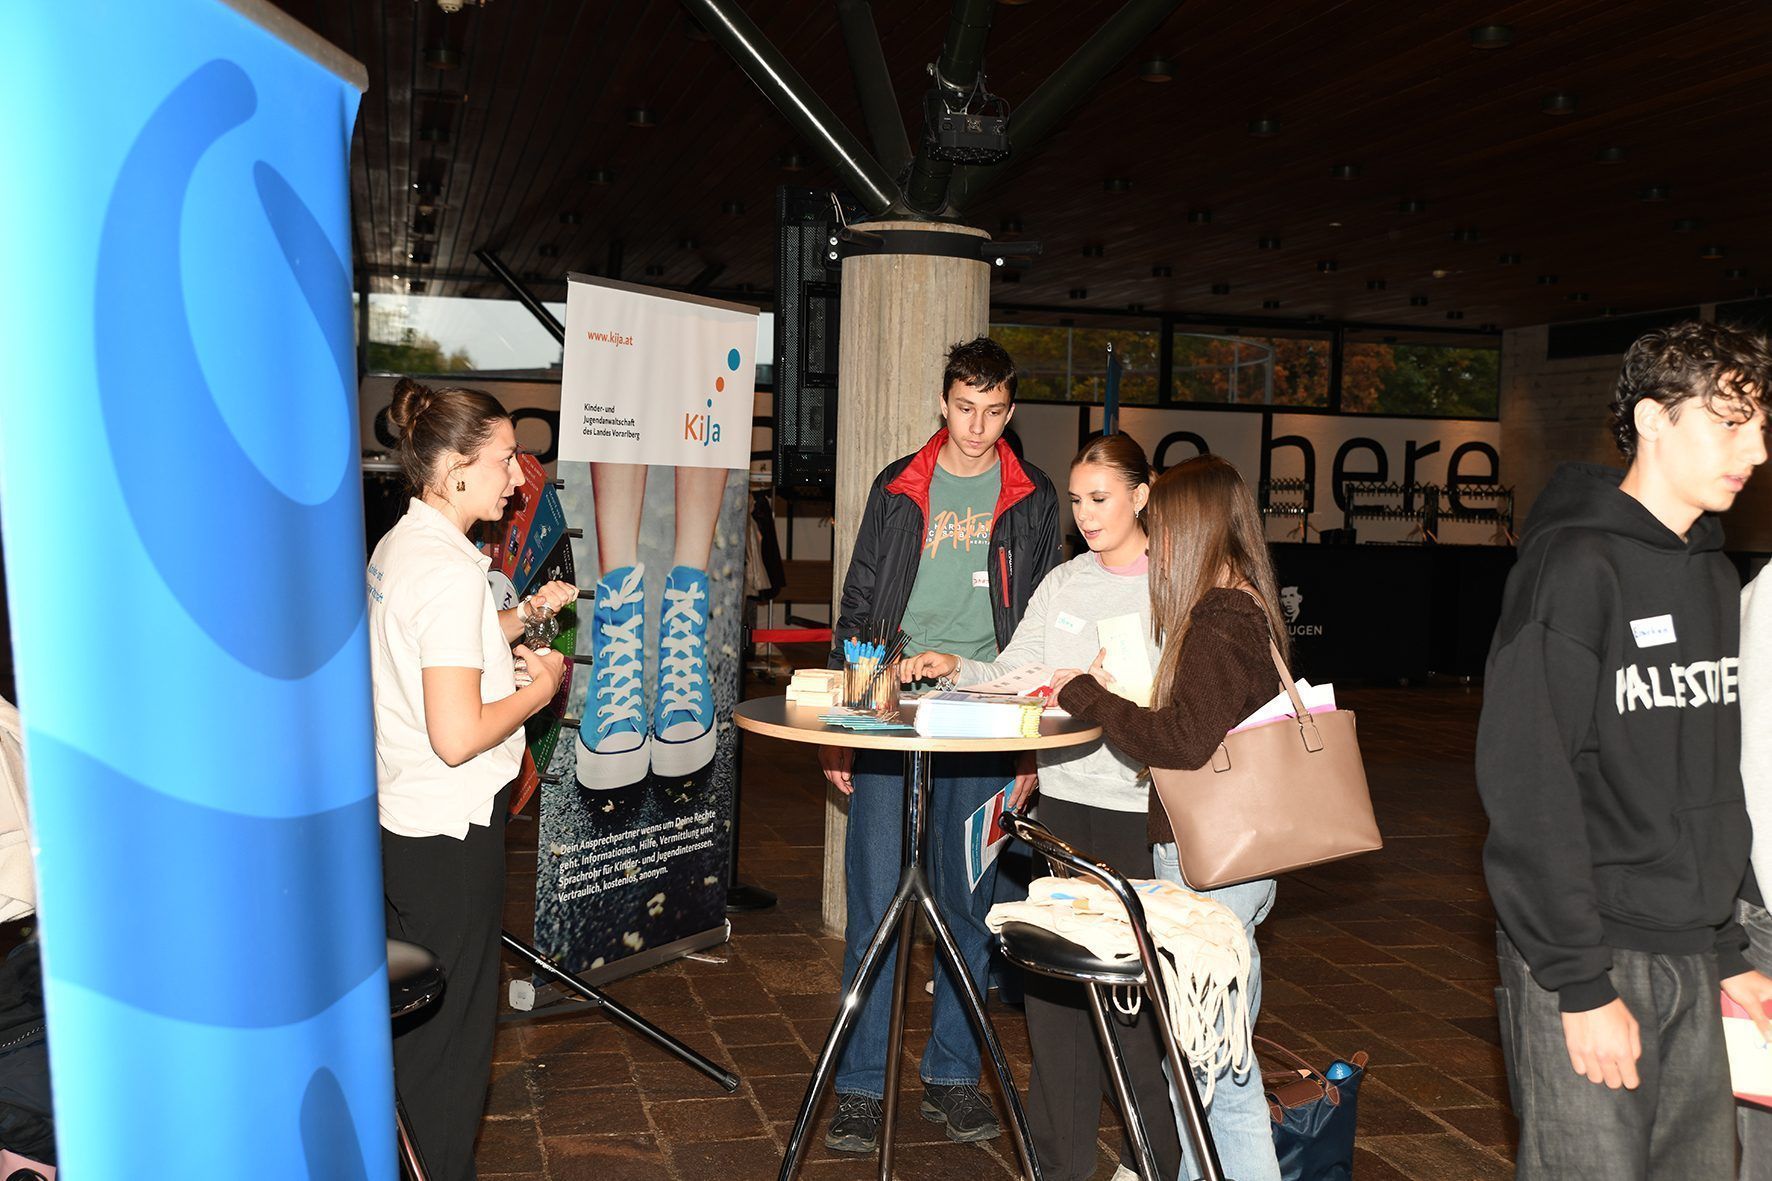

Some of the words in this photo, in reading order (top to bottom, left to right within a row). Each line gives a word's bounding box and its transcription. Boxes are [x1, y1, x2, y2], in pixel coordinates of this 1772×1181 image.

[587, 331, 633, 347] www.kija.at
[583, 415, 635, 426] Jugendanwaltschaft
[605, 405, 615, 413] und
[583, 427, 592, 435] des
[593, 428, 611, 436] Landes
[612, 429, 640, 441] Vorarlberg
[684, 412, 721, 446] KiJa
[1260, 411, 1500, 514] here
[1285, 625, 1323, 635] UGEN
[560, 842, 579, 855] Dein
[580, 829, 640, 850] Ansprechpartner
[641, 824, 662, 835] wenns
[662, 821, 674, 830] um
[675, 816, 693, 827] Deine
[694, 810, 716, 822] Rechte
[560, 857, 580, 874] geht.
[581, 845, 638, 865] Informationen,
[639, 838, 658, 850] Hilfe,
[660, 829, 699, 845] Vermittlung
[700, 823, 714, 834] und
[558, 868, 602, 889] Sprachrohr
[602, 864, 613, 875] für
[614, 859, 641, 872] Kinder-
[641, 852, 655, 865] und
[656, 840, 714, 862] Jugendinteressen.
[558, 882, 602, 902] Vertraulich,
[603, 874, 638, 890] kostenlos,
[639, 866, 668, 880] anonym.
